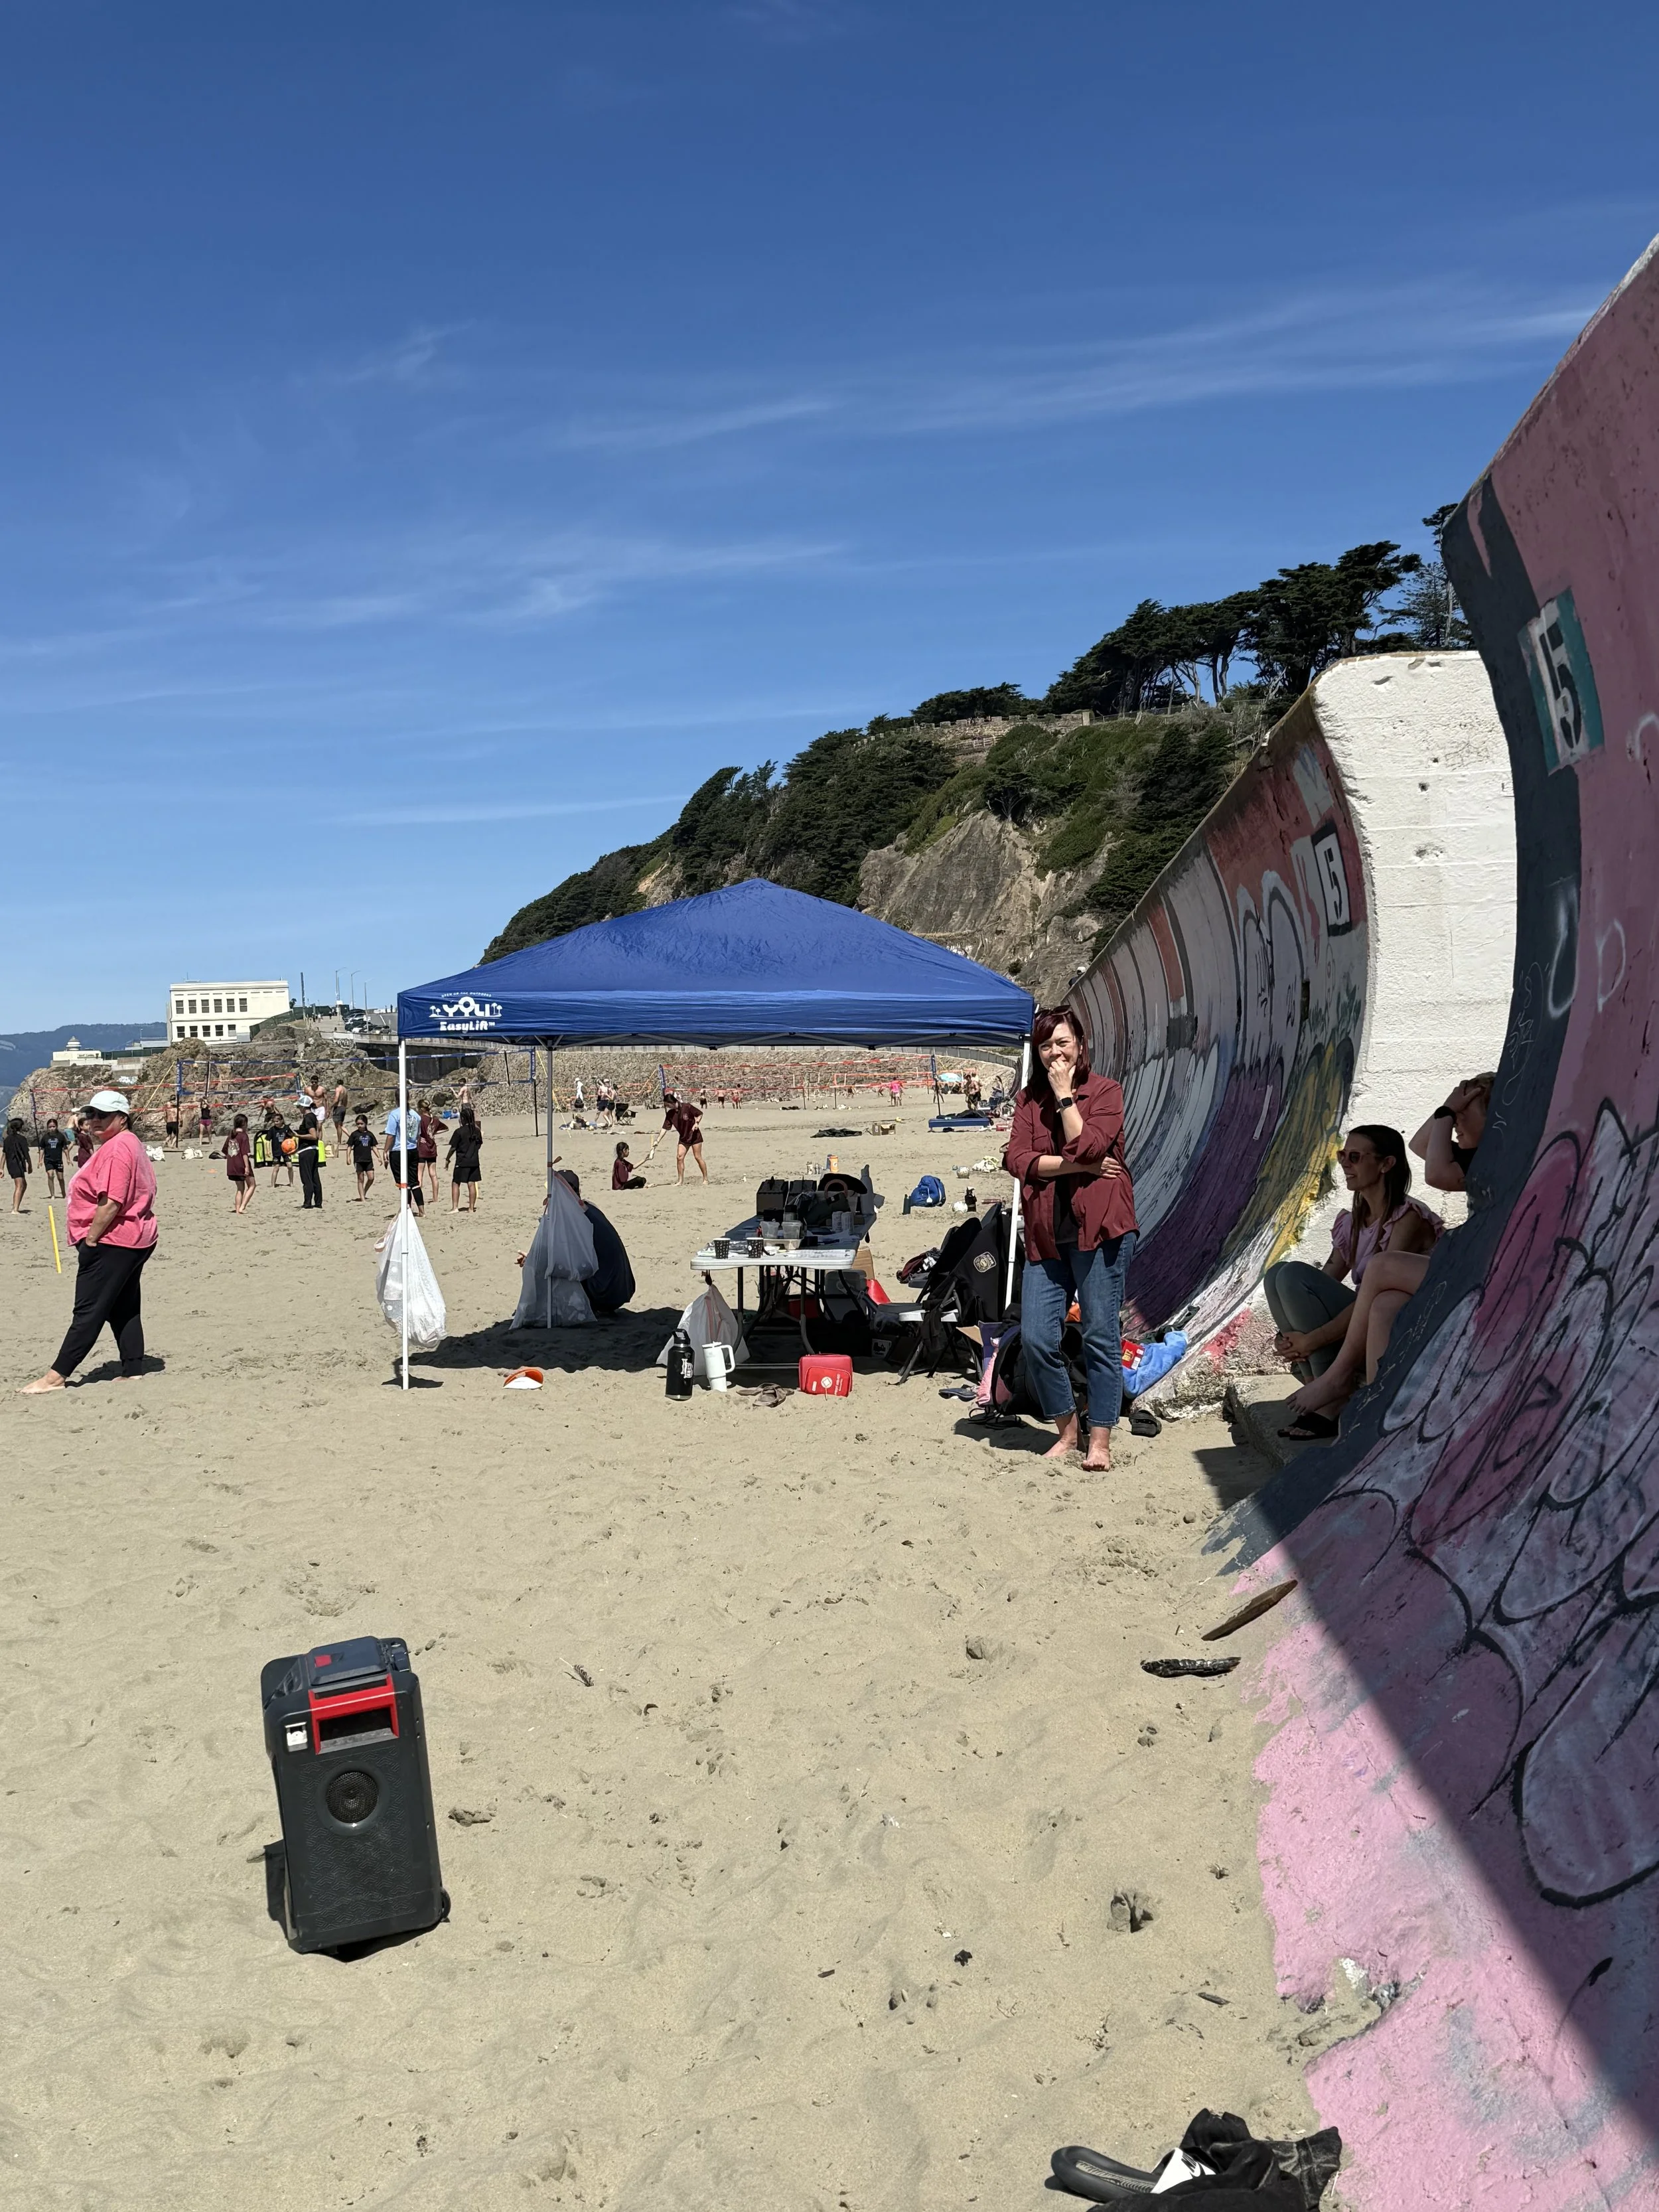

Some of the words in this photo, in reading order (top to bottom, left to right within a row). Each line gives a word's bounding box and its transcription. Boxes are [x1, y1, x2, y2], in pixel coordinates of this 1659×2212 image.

[1539, 621, 1582, 750] 5
[1323, 847, 1343, 921] 5
[442, 996, 490, 1017] YOLI
